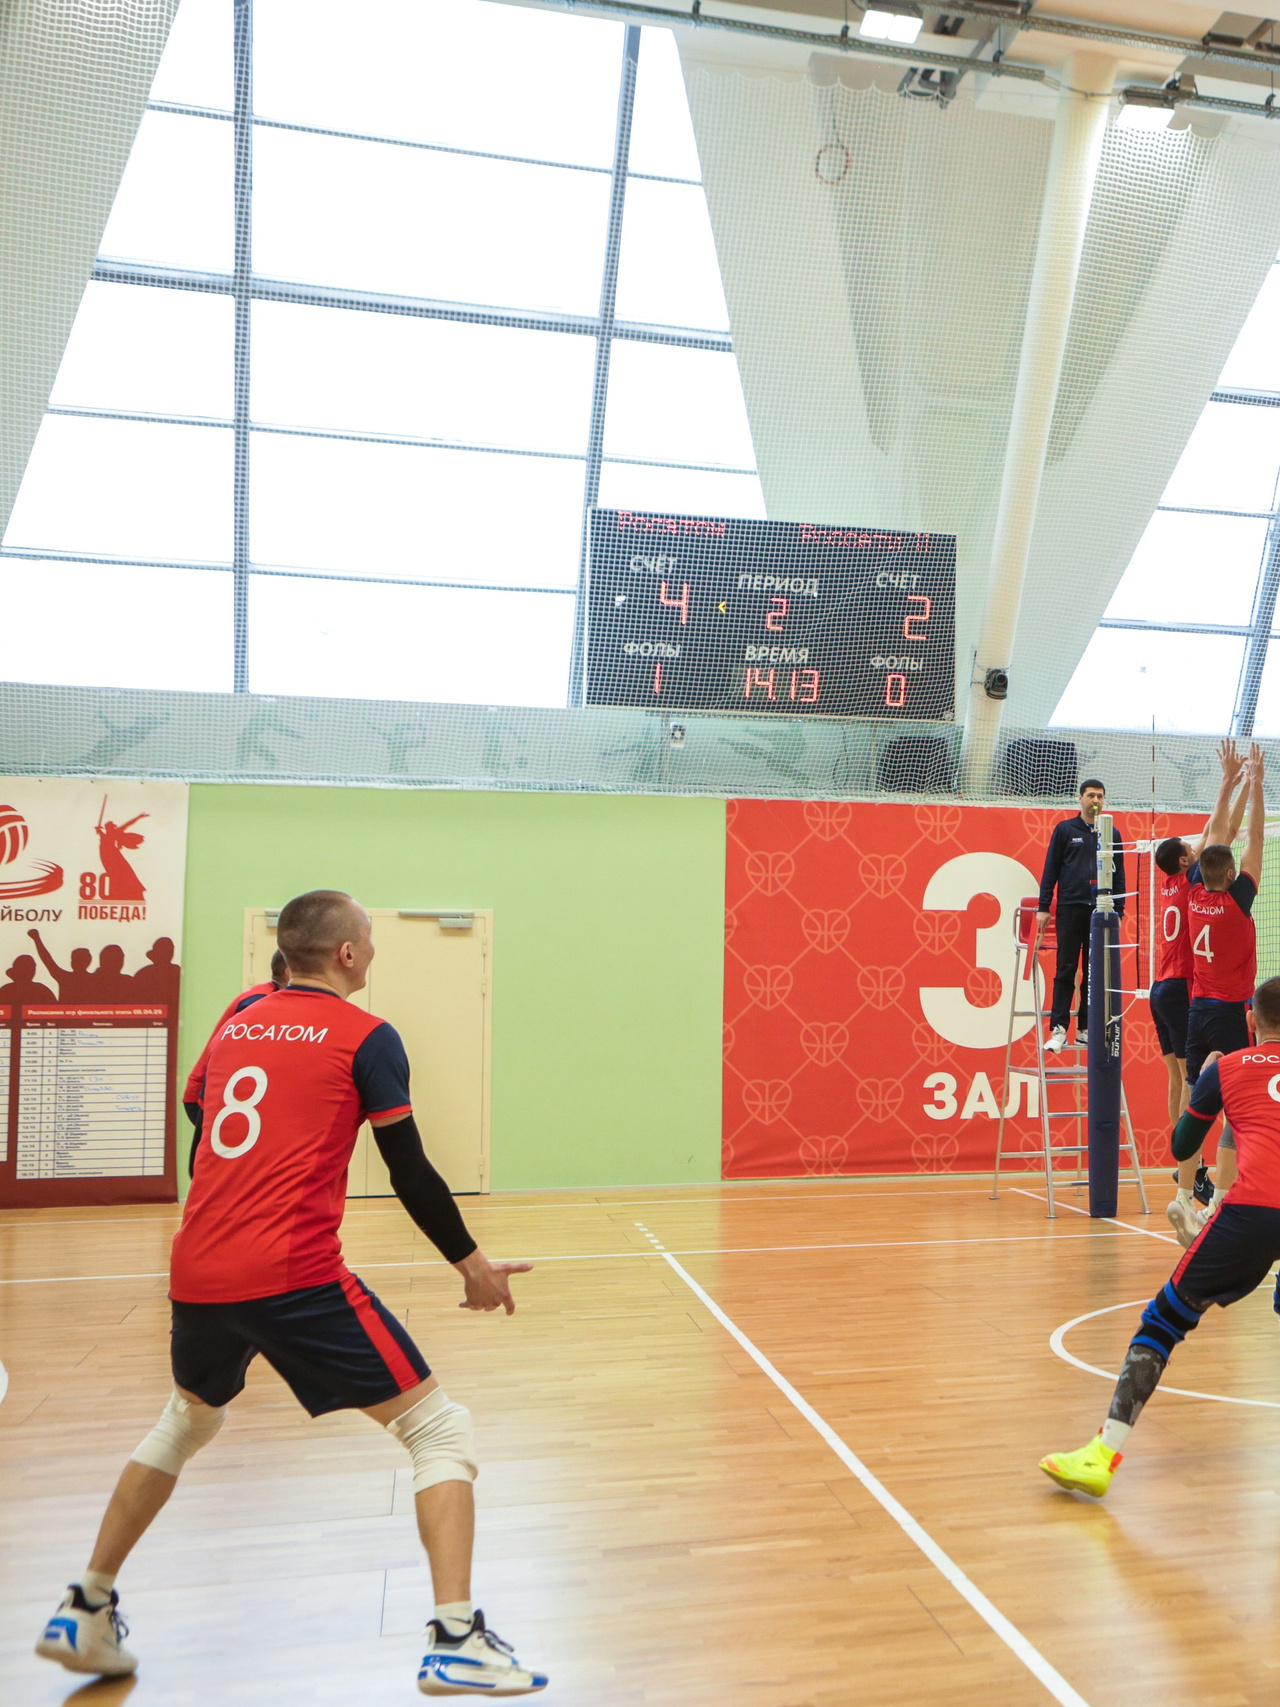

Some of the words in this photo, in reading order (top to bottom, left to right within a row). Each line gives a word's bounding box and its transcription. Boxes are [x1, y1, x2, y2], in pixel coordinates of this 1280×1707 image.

[737, 574, 818, 596] ПЕРИОД
[660, 580, 689, 625] 4
[766, 597, 788, 631] 2
[903, 595, 931, 640] 2
[623, 641, 681, 657] ФОЛЫ
[745, 645, 809, 663] ВРЕМЯ
[870, 654, 923, 670] ФОЛЫ
[654, 662, 662, 694] 1
[885, 673, 906, 706] 0
[79, 871, 110, 901] 80
[78, 905, 147, 922] ПОБЕДА!
[919, 852, 1045, 1049] 3
[1193, 924, 1215, 963] 4
[220, 1023, 329, 1044] РОСАТОМ
[922, 1071, 1040, 1120] ЗАЛ
[210, 1065, 269, 1160] 8
